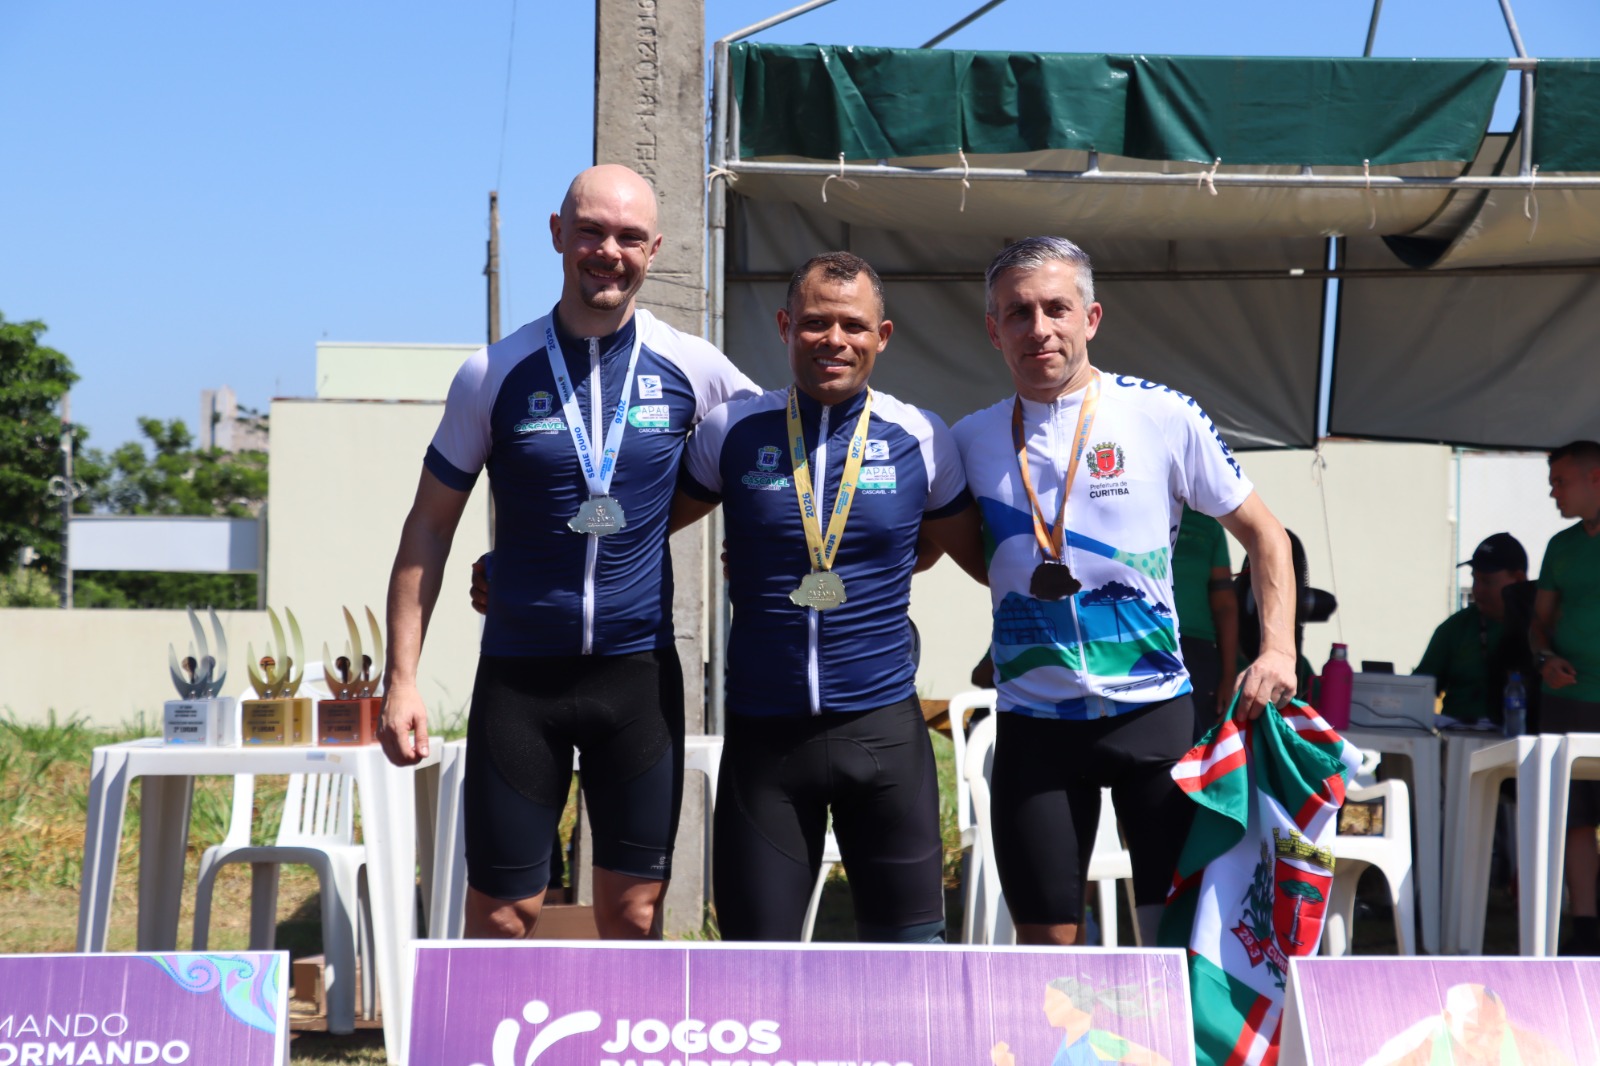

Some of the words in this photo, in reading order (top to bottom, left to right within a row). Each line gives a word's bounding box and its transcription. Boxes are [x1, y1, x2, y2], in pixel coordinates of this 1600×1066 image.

[545, 328, 556, 351] 2026
[615, 400, 627, 425] 2026
[641, 405, 669, 415] APAC
[514, 421, 568, 433] CASCAVEL
[574, 426, 588, 451] OURO
[851, 435, 863, 459] 2026
[581, 452, 595, 479] SÉRIE
[866, 467, 895, 476] APAC
[742, 475, 790, 488] CASCAVEL
[1089, 482, 1118, 490] Prefeitura
[1089, 487, 1129, 499] CURITIBA
[802, 492, 814, 518] 2026
[601, 1018, 782, 1054] JOGOS
